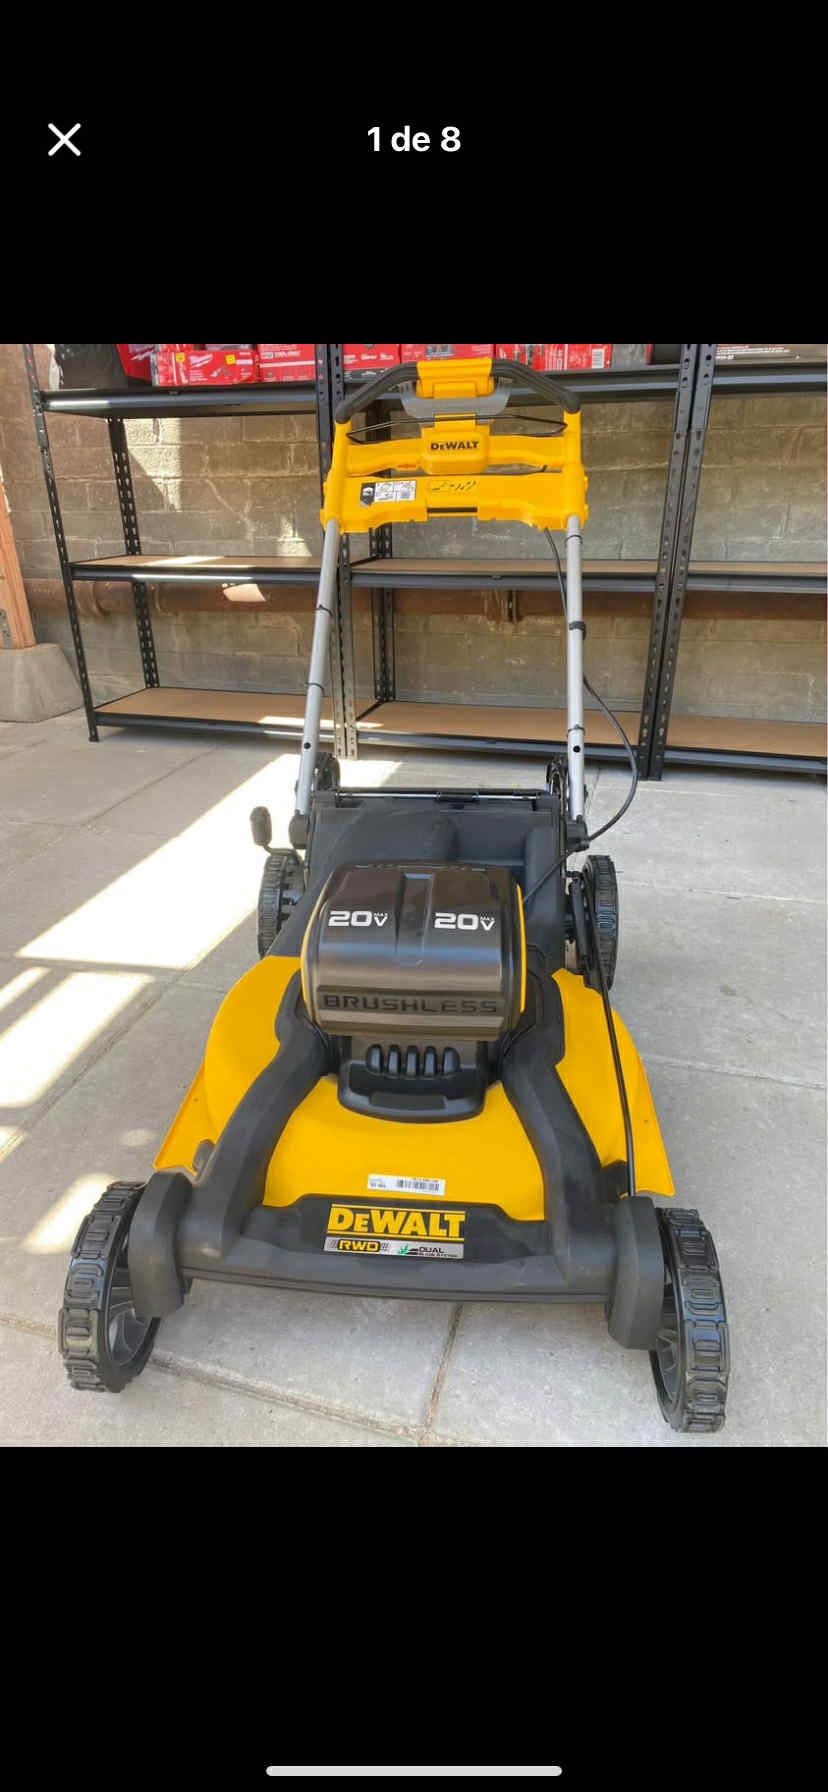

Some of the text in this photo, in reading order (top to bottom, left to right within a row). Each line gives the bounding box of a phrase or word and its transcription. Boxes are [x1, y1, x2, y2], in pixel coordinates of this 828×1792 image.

[430, 440, 479, 451] DEWALT
[324, 995, 496, 1013] BRUSHLESS
[328, 1207, 466, 1237] DEWALT
[339, 1240, 380, 1252] RWD
